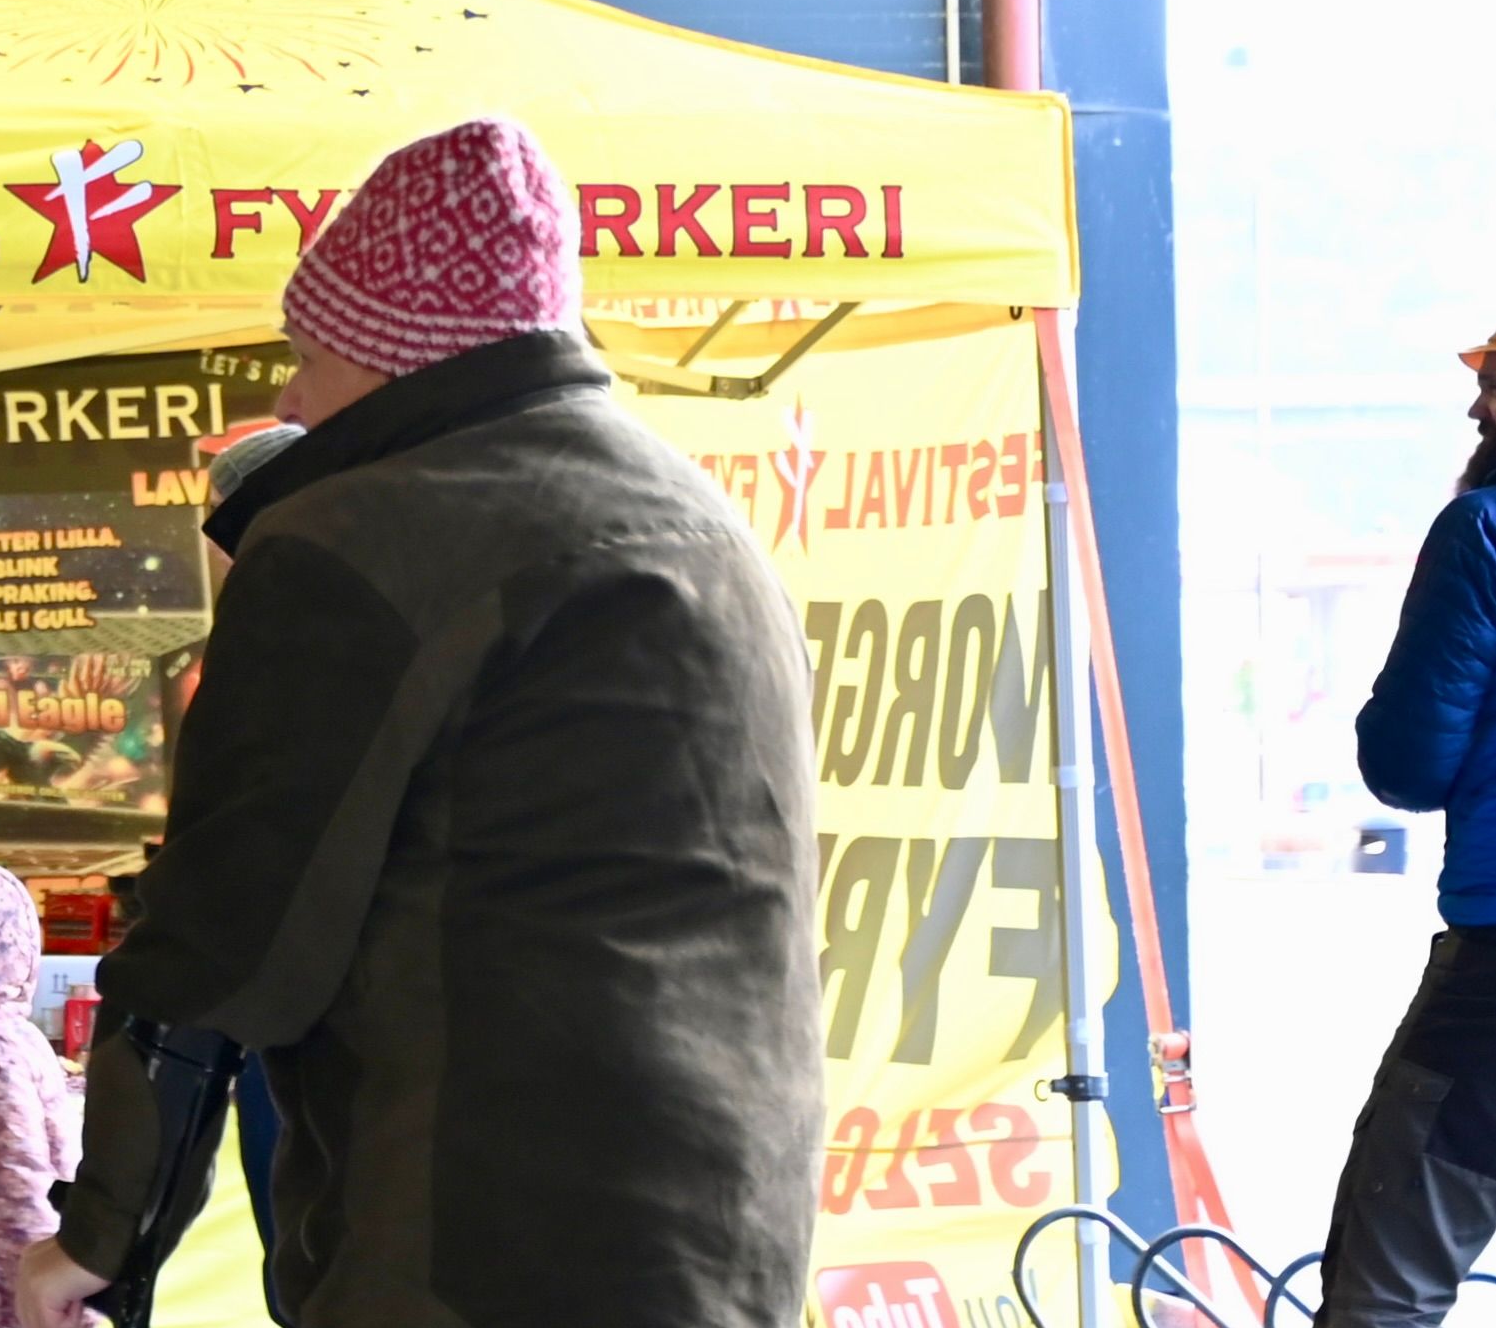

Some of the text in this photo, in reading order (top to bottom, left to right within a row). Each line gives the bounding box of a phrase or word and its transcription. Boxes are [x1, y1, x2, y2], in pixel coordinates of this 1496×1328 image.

[211, 181, 903, 260] FYRKERI
[131, 469, 210, 507] LAV
[56, 527, 123, 549] LILLA.
[33, 607, 95, 630] GULL.
[16, 688, 127, 734] Eagle
